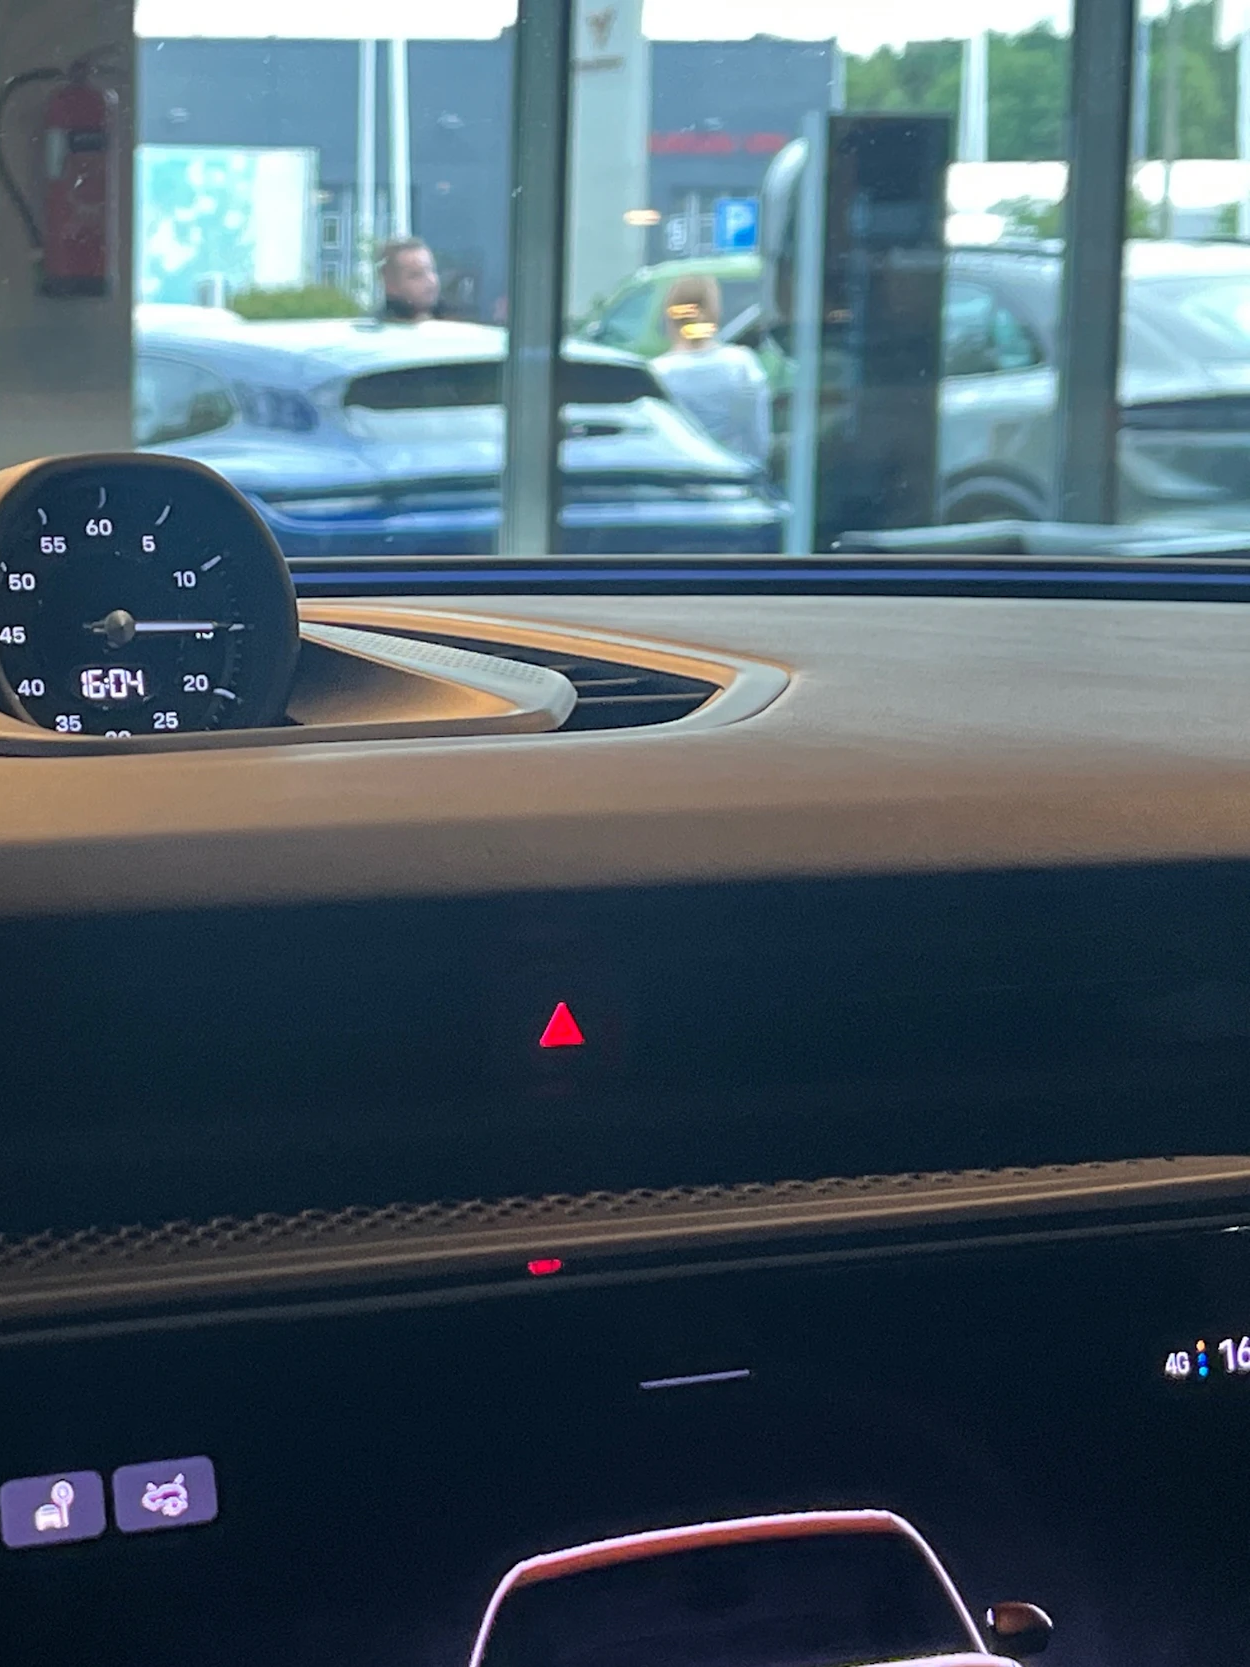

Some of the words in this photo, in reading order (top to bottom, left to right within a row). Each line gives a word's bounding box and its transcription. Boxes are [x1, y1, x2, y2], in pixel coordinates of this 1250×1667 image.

[726, 203, 752, 241] P
[85, 519, 113, 536] 60
[40, 536, 67, 554] 55
[142, 535, 156, 552] 5
[8, 573, 36, 591] 50
[173, 570, 196, 588] 10
[17, 679, 45, 697] 40
[81, 668, 145, 699] 16:04
[183, 674, 209, 692] 20
[55, 715, 82, 733] 35
[153, 711, 179, 729] 25
[1165, 1351, 1190, 1375] 4G
